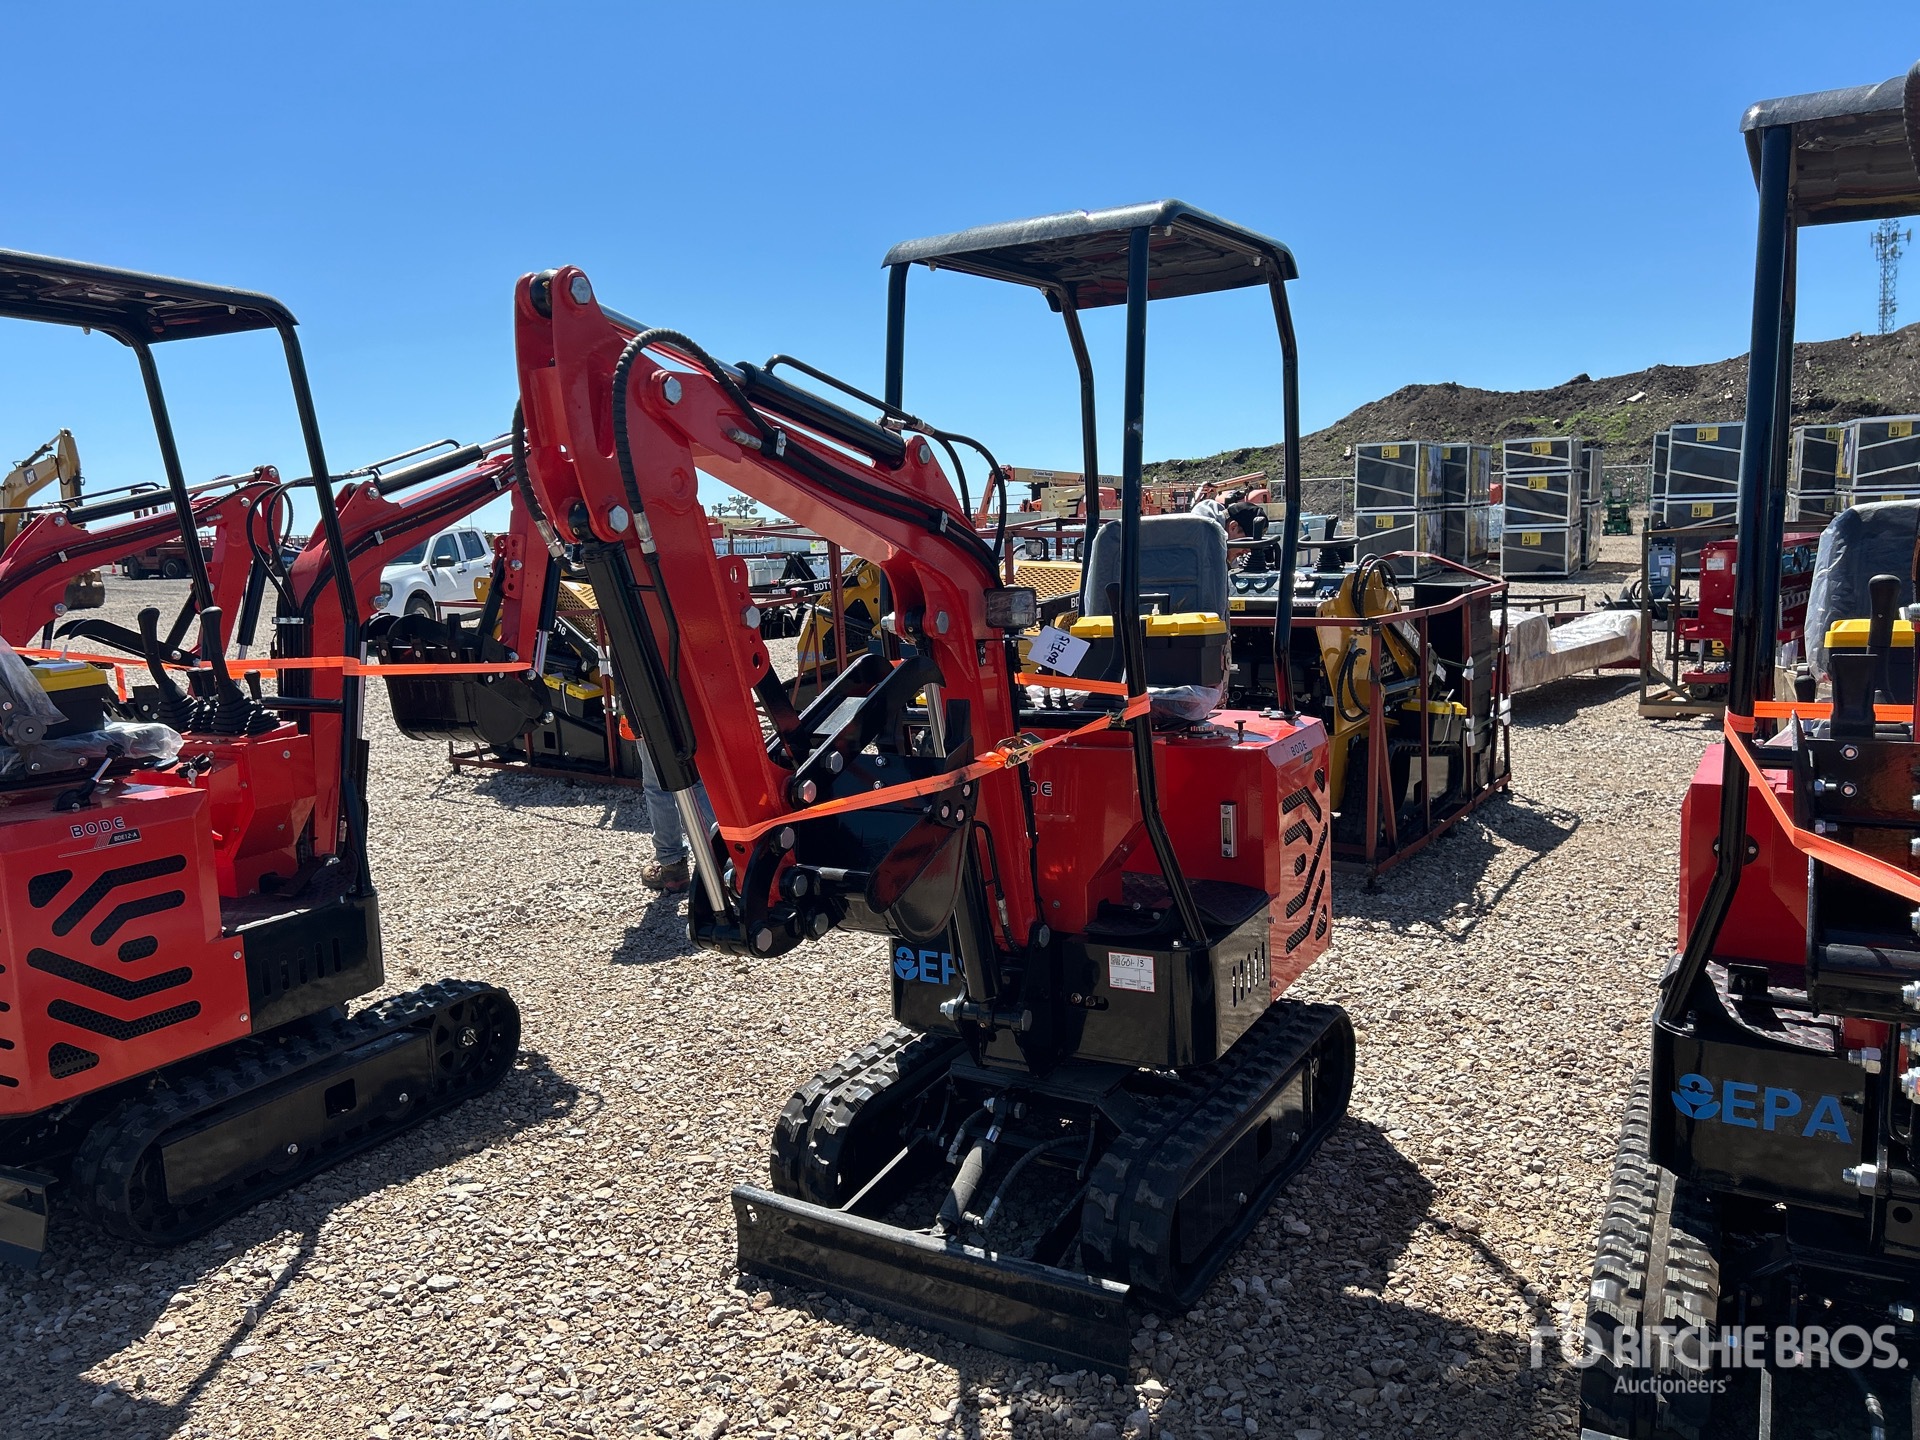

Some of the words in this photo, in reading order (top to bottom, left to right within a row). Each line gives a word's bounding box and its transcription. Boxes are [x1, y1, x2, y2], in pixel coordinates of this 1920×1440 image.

[813, 581, 832, 592] BDT1
[1290, 740, 1308, 757] BODE
[70, 816, 126, 839] BODE
[1721, 1080, 1853, 1145] EPA
